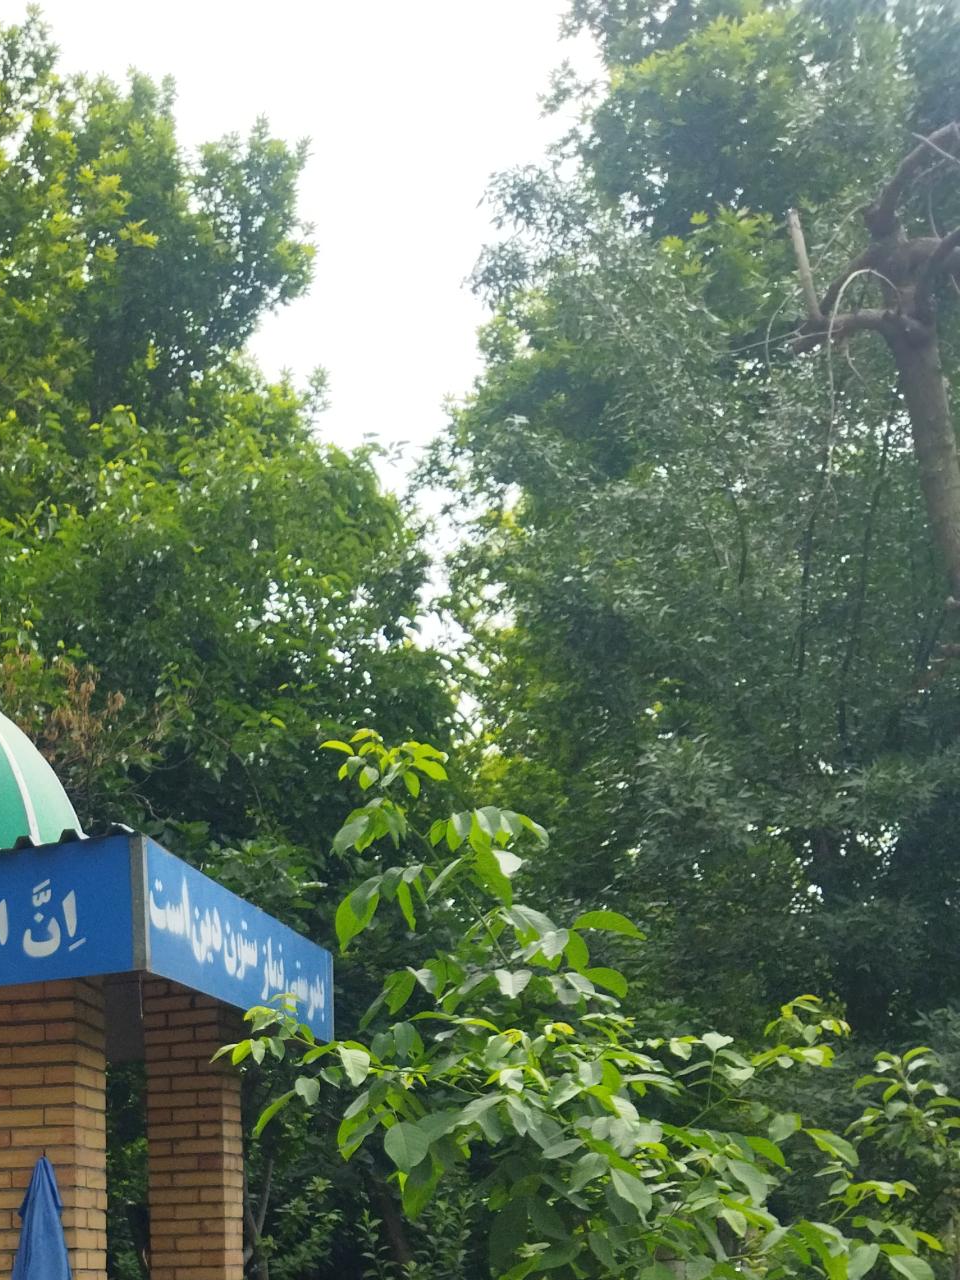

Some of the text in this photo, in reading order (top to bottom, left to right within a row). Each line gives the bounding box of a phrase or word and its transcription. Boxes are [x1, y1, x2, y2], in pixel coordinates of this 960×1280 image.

[149, 875, 190, 939] است
[192, 906, 222, 964] دین
[223, 920, 258, 981] ستون
[261, 936, 284, 1001] نماز
